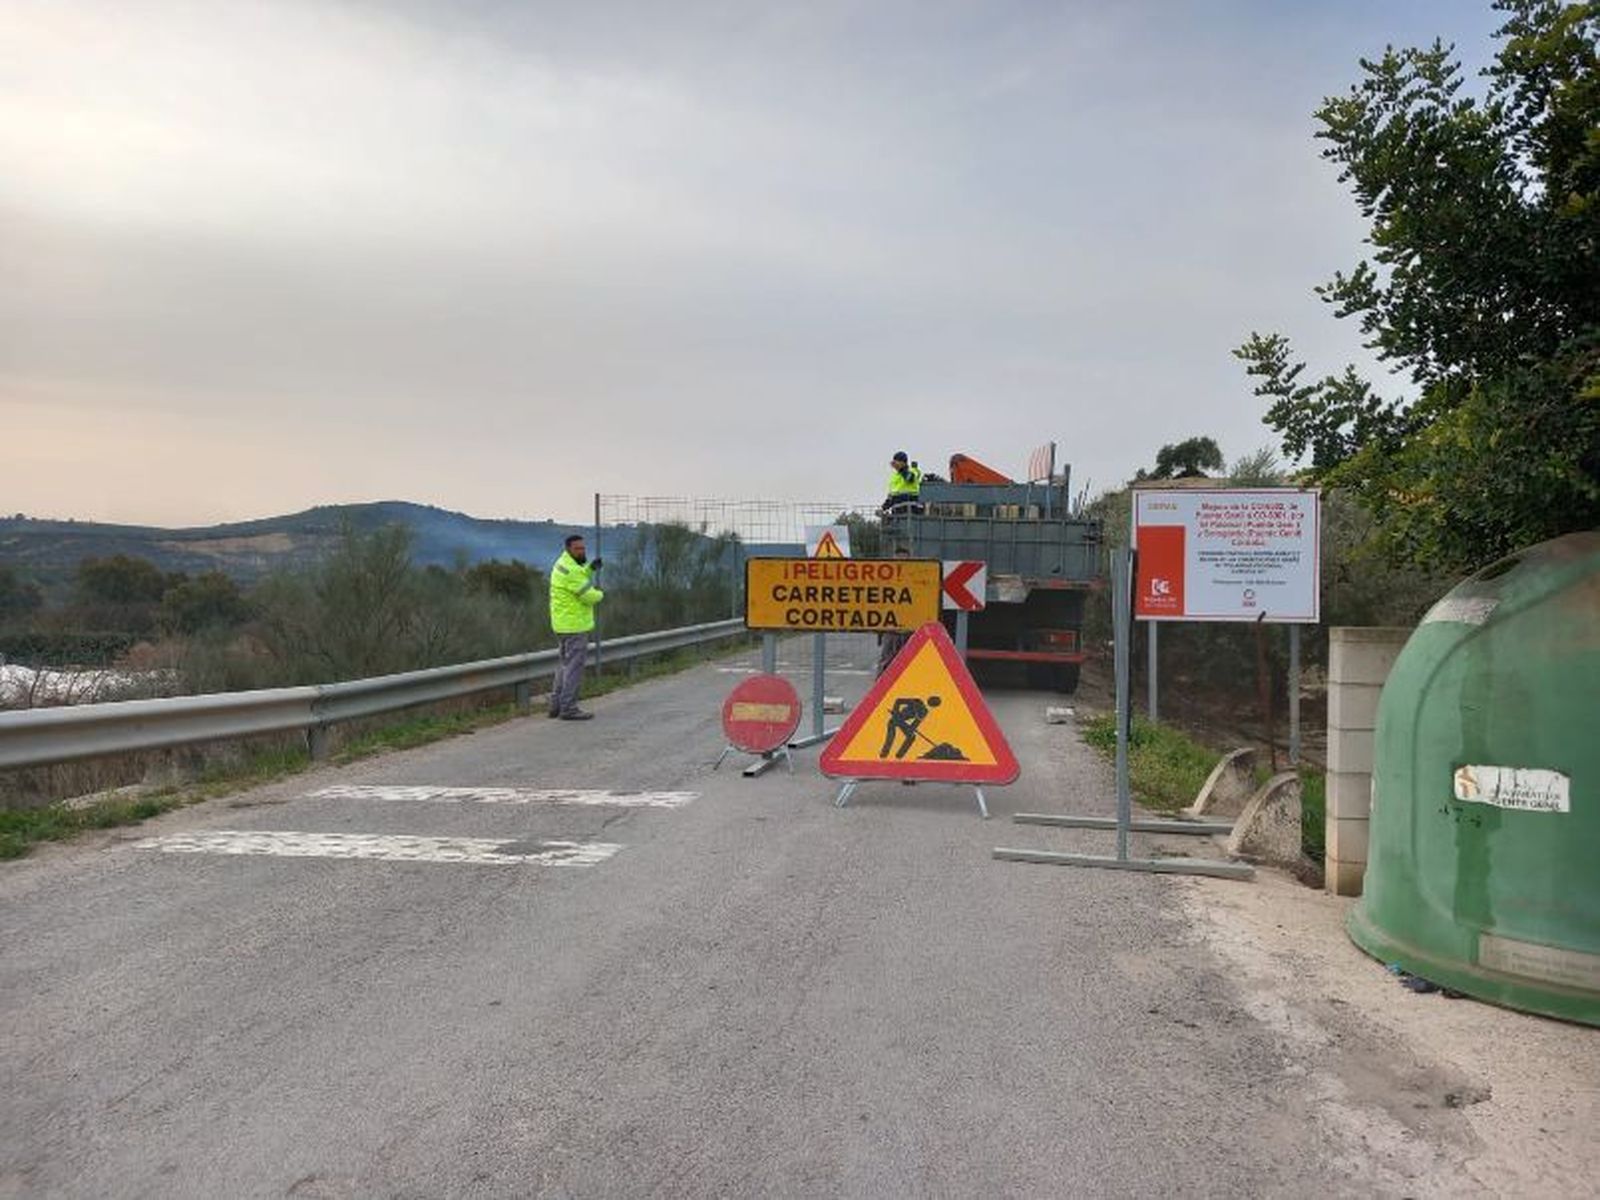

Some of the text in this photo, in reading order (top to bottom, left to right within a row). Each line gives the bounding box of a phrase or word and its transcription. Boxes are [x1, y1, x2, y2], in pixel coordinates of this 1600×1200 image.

[783, 563, 903, 581] ¡PELIGRO!
[772, 585, 912, 605] CARRETERA
[786, 608, 898, 627] CORTADA
